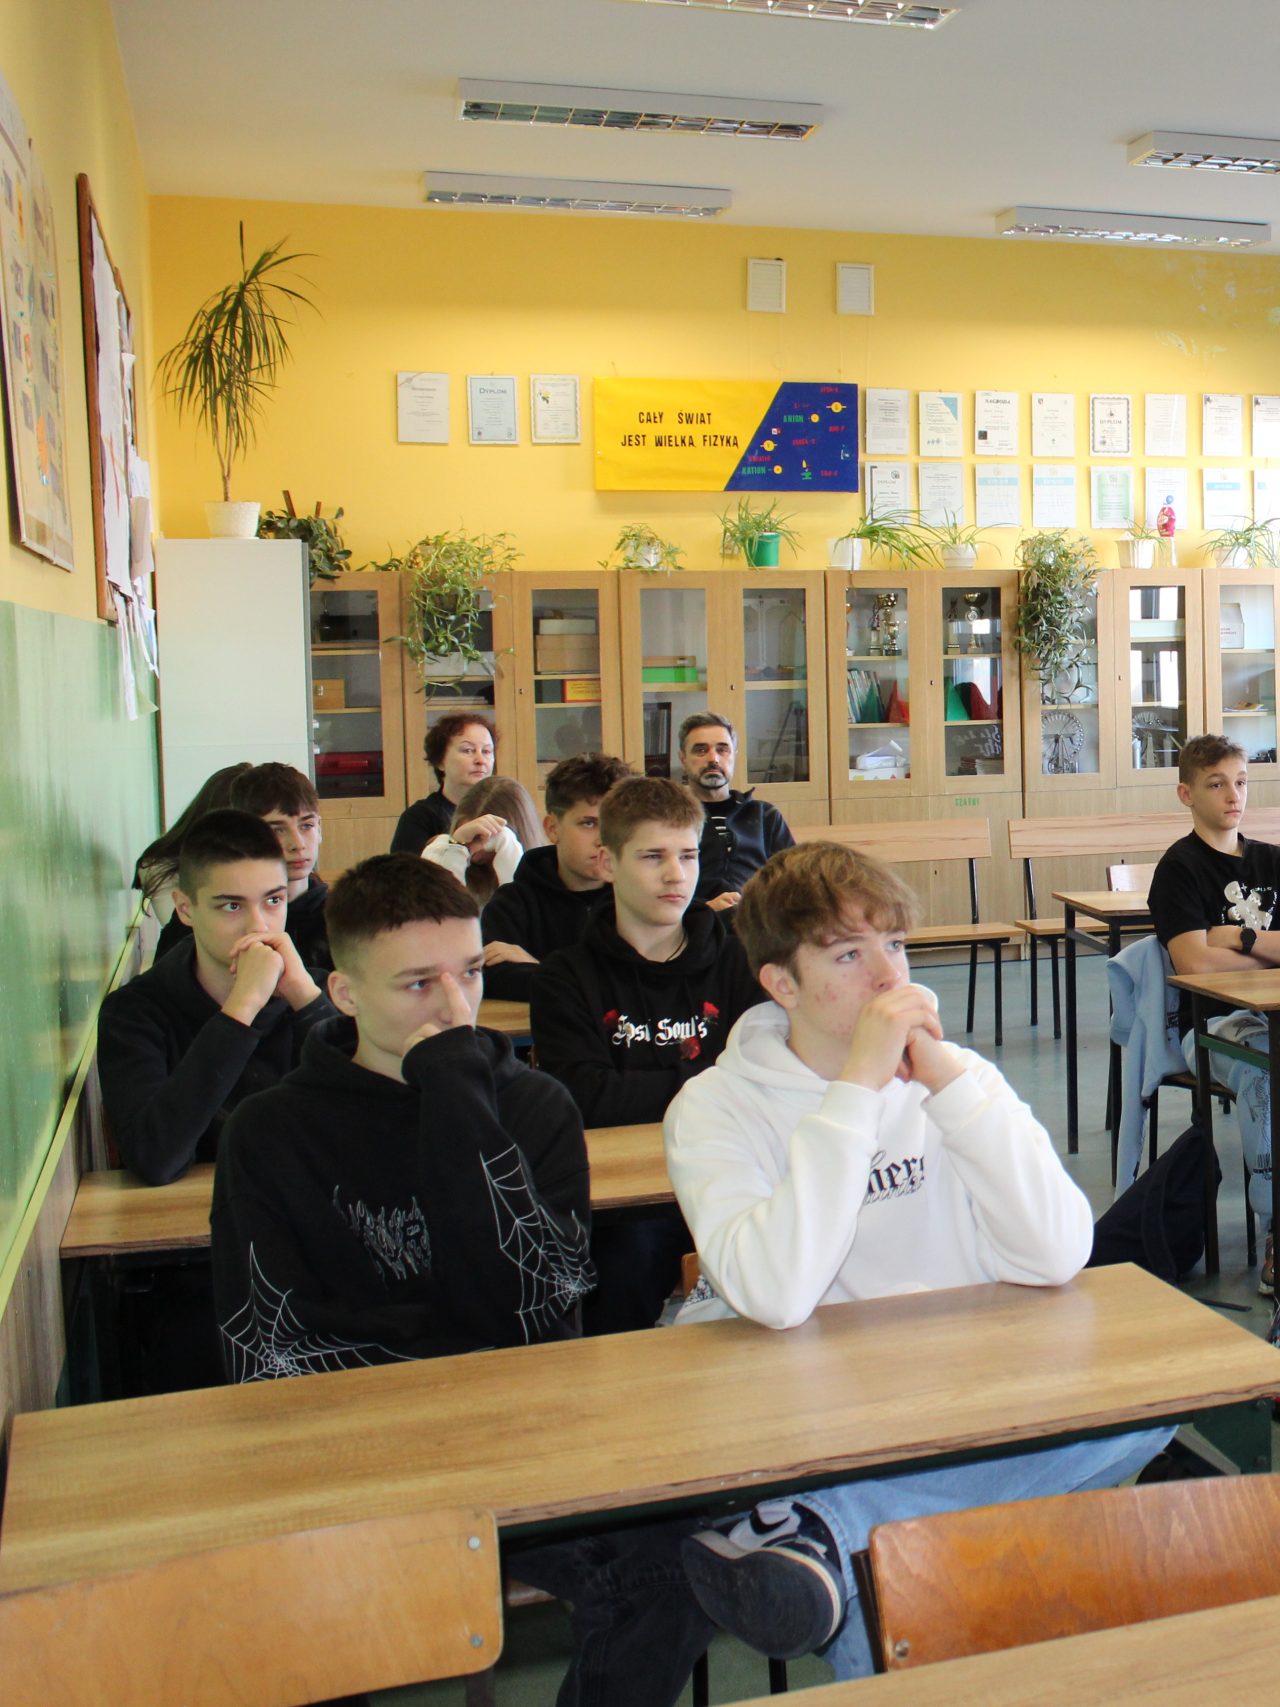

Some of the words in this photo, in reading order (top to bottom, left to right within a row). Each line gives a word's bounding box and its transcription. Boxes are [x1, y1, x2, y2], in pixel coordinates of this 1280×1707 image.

[638, 411, 664, 424] CAŁY
[677, 409, 712, 425] ŚWIAT
[621, 434, 646, 447] JEST
[654, 434, 695, 448] WIELKA
[702, 434, 739, 449] FIZYKĄ
